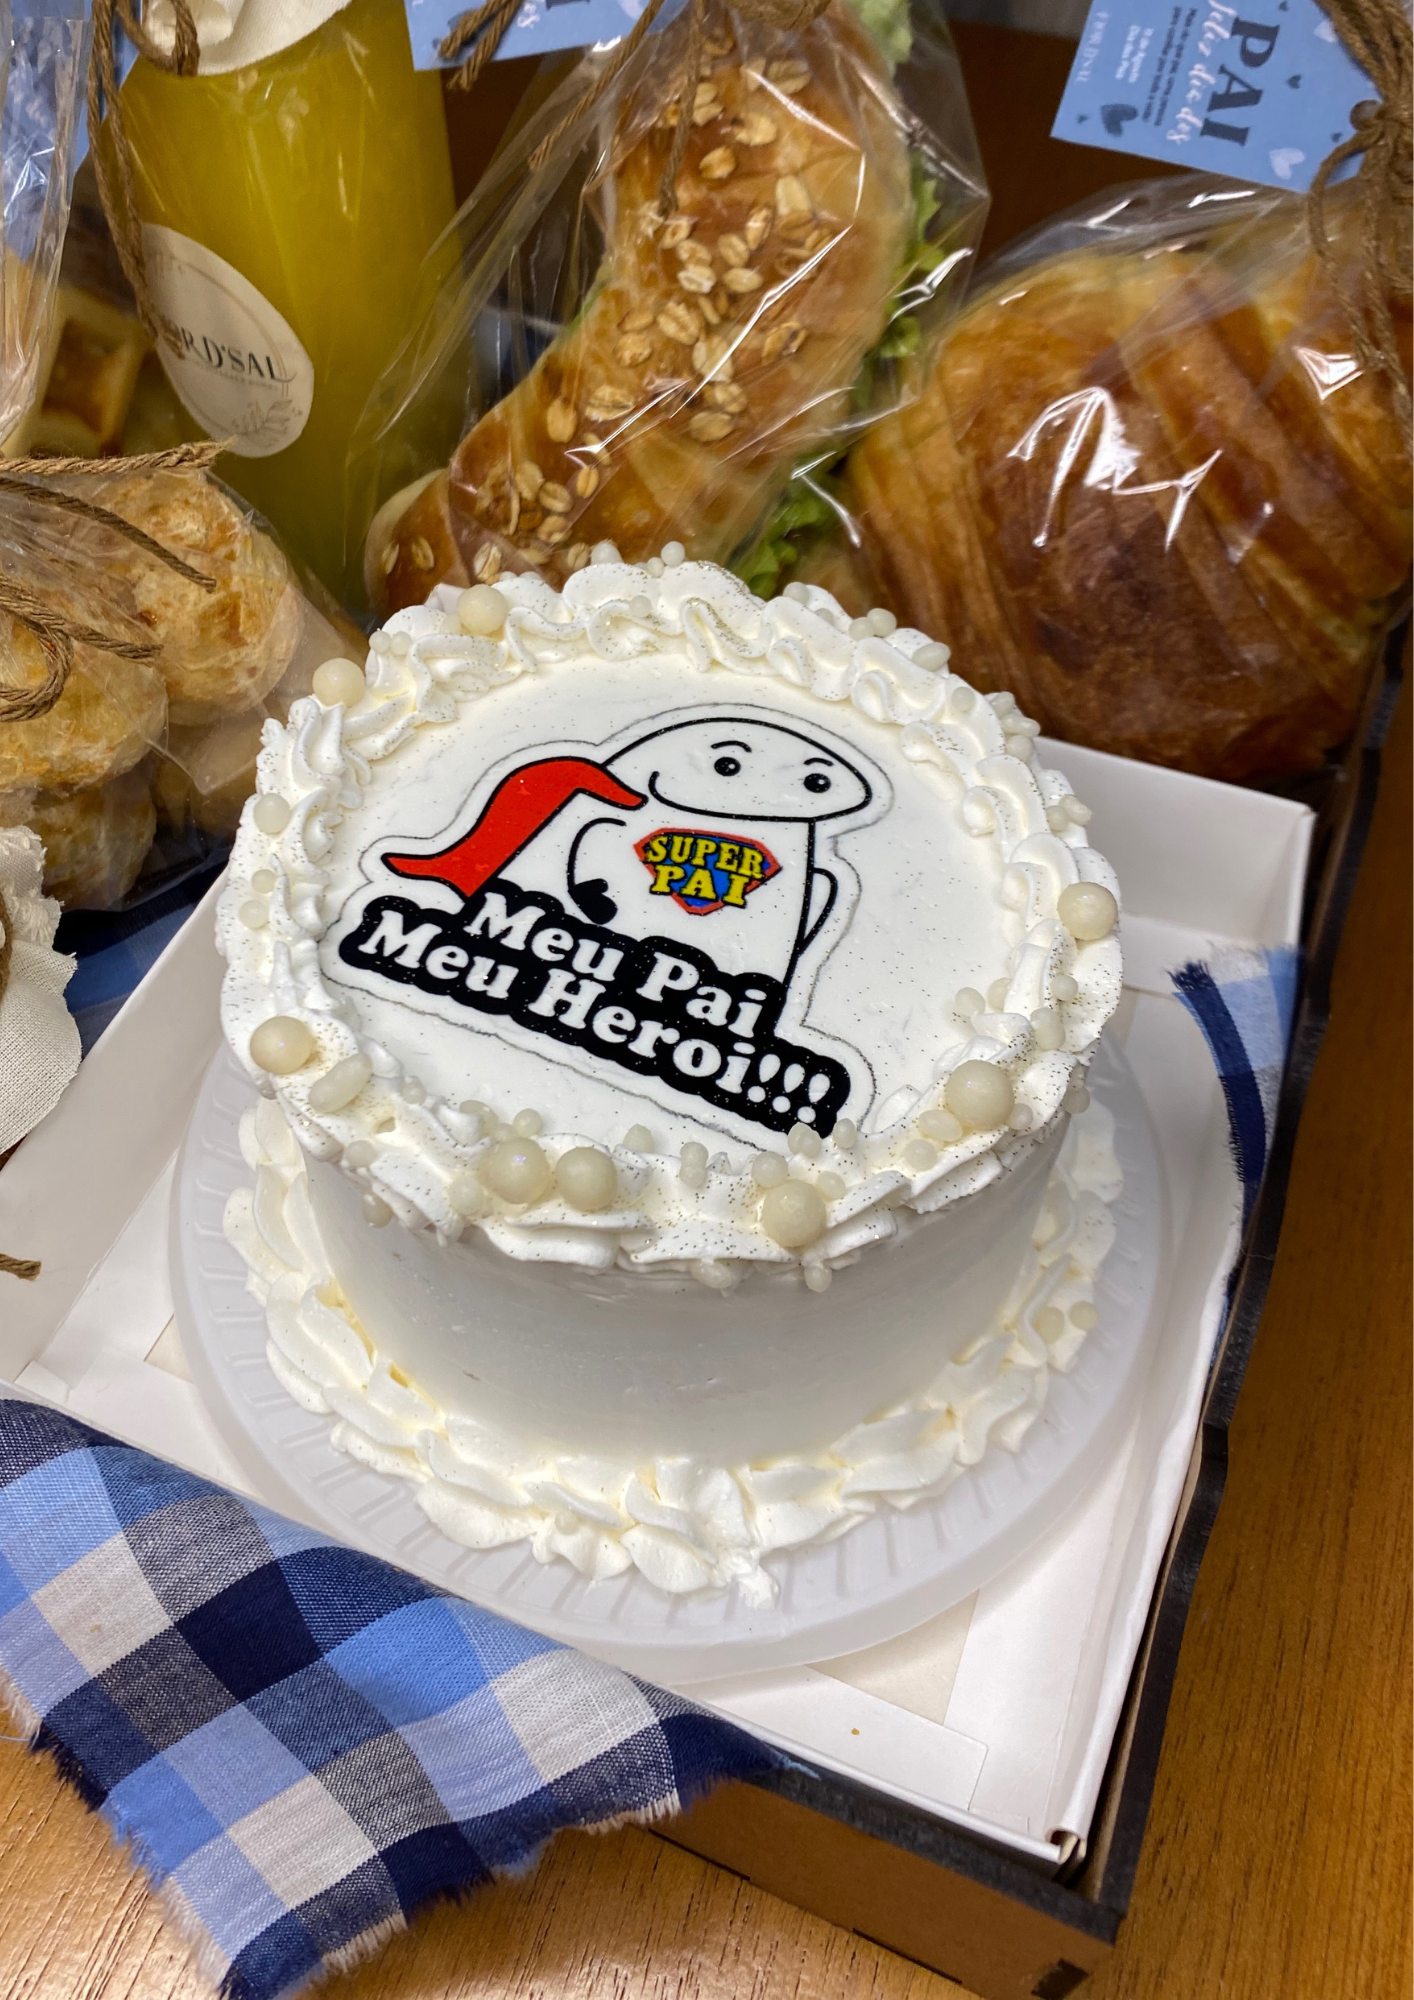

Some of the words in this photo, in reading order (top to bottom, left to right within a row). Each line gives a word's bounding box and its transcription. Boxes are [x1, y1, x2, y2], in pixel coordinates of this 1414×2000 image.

[1186, 63, 1216, 103] dia
[1200, 17, 1280, 146] PAI
[644, 834, 766, 880] SUPER
[650, 862, 750, 909] PAI
[464, 892, 624, 983] Meu
[635, 950, 768, 1039] Pai
[358, 910, 519, 1000] Meu
[528, 967, 832, 1125] Heroi!!!
